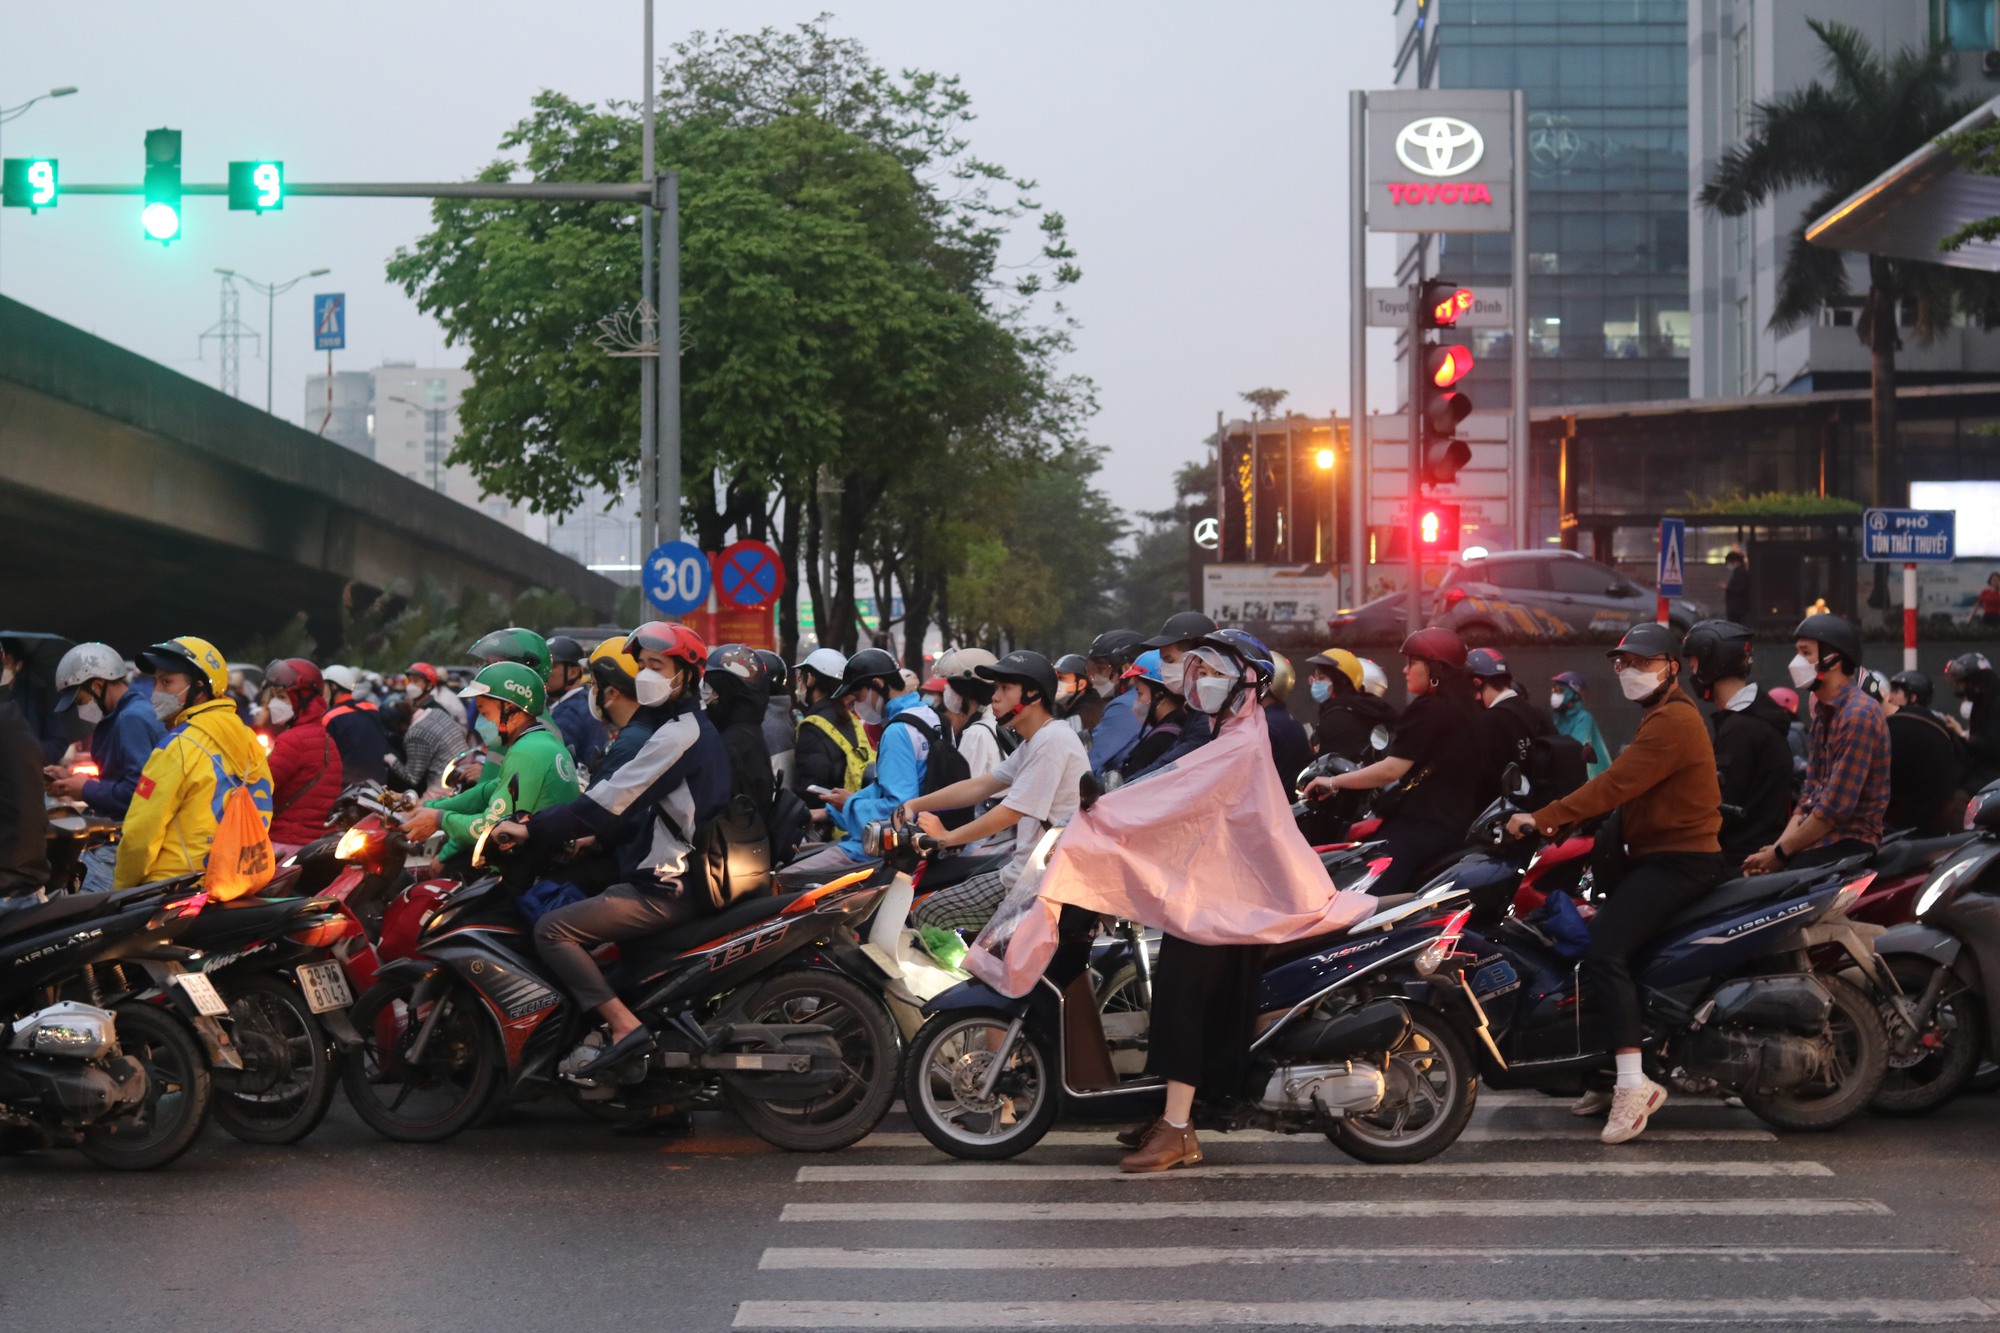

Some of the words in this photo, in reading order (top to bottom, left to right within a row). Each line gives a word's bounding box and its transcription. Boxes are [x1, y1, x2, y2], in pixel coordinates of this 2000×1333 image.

[28, 161, 55, 204] 9
[253, 164, 280, 206] 9
[1388, 183, 1493, 205] TOYOTA
[1895, 512, 1929, 529] PHỐ
[1872, 531, 1889, 553] TÔN
[1891, 529, 1913, 553] THẤT
[653, 557, 702, 601] 30
[205, 650, 221, 670] be
[504, 680, 532, 699] Grab
[709, 923, 790, 973] 135
[1308, 936, 1390, 964] VISION
[314, 984, 347, 1008] 8043
[510, 992, 560, 1020] EXCITER
